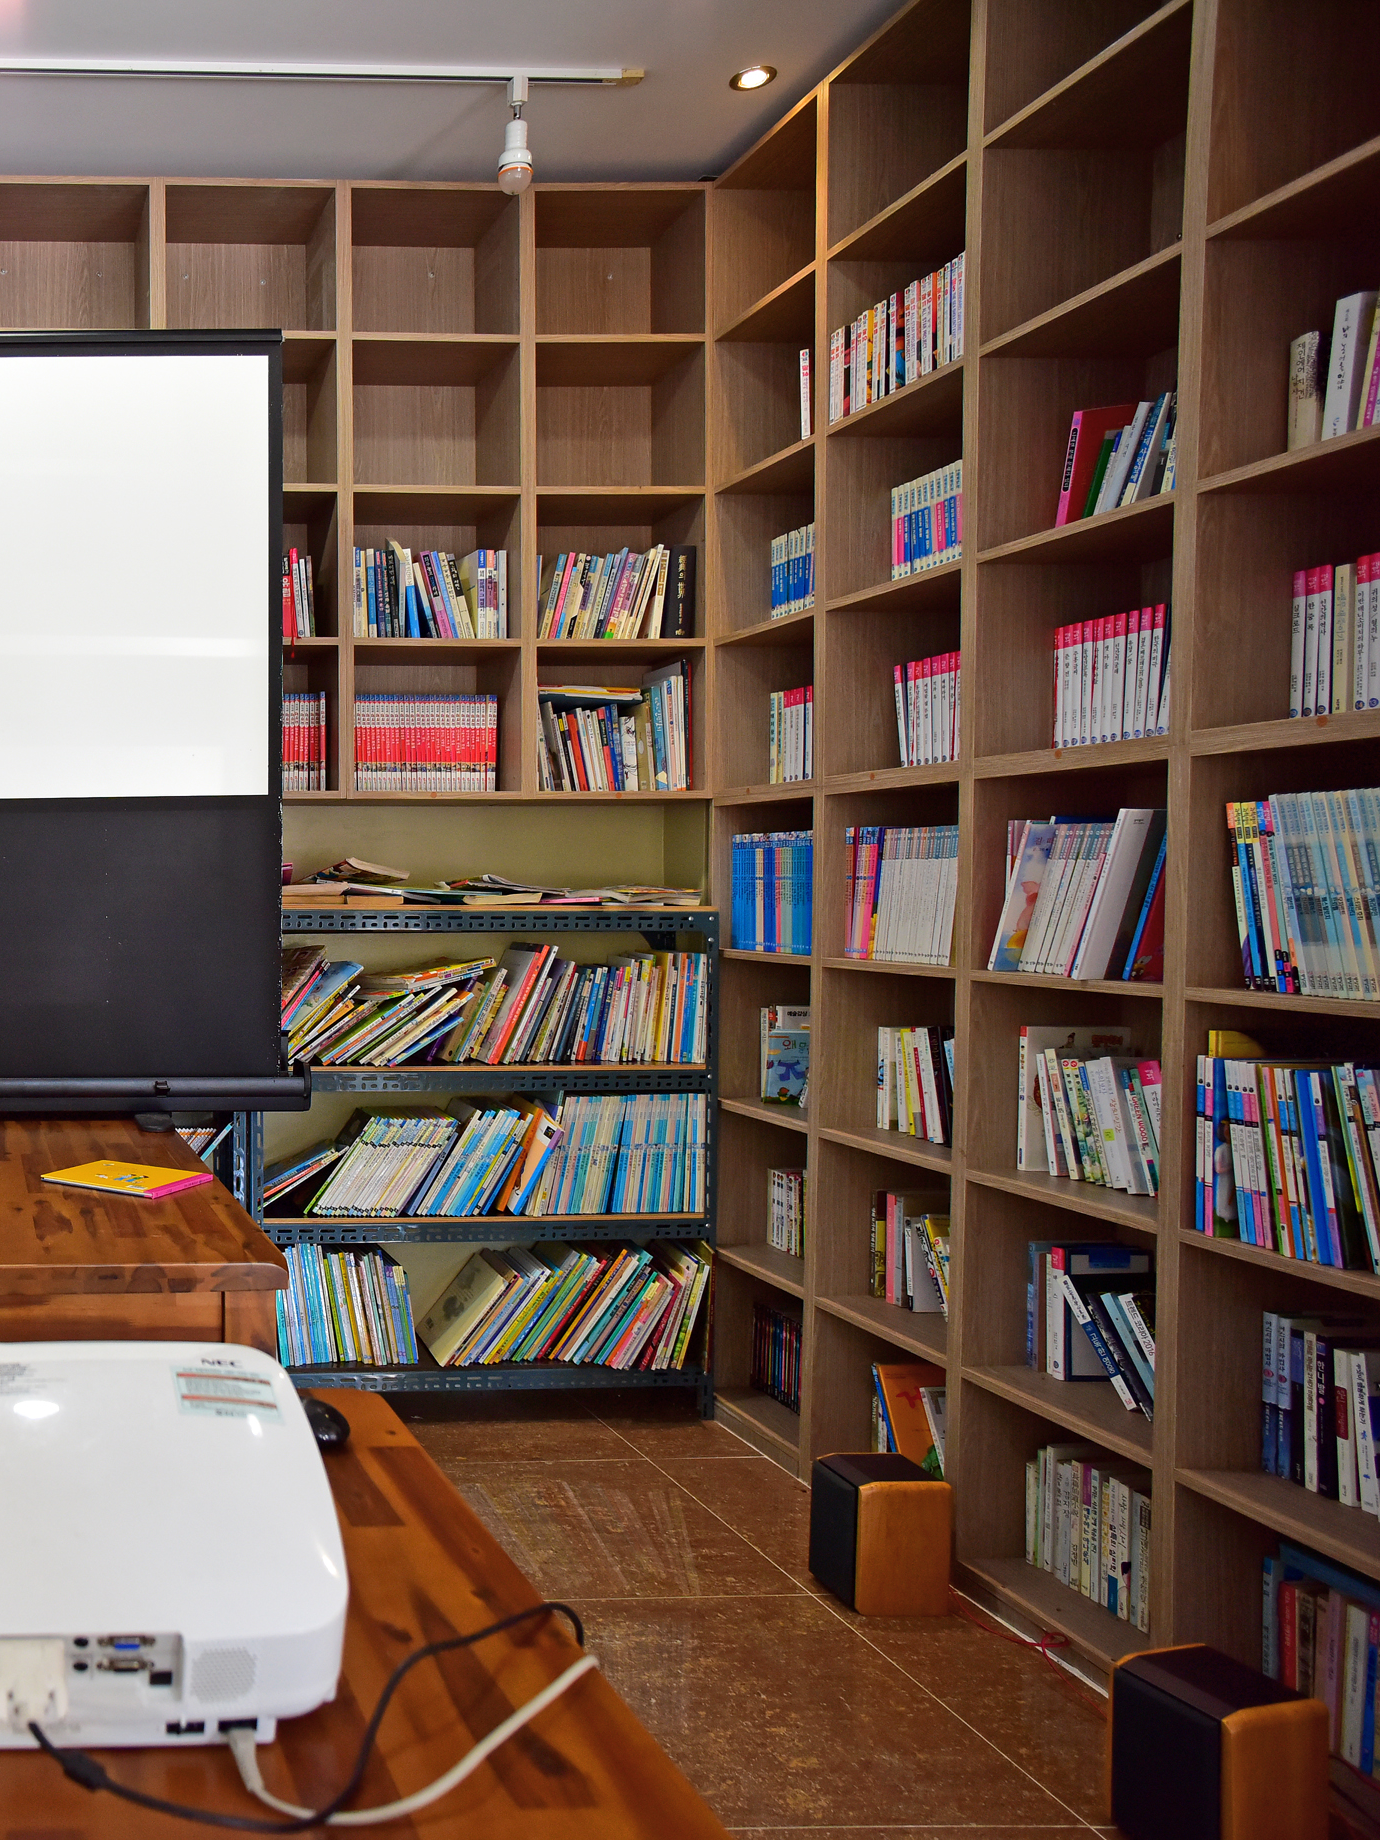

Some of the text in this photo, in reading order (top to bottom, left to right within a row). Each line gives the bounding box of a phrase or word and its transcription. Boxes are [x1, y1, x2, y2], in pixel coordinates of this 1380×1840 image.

[1131, 1095, 1148, 1146] GREEN WOOD
[1124, 1300, 1155, 1357] 트렌드 코리아 2016
[201, 1358, 241, 1367] NEC
